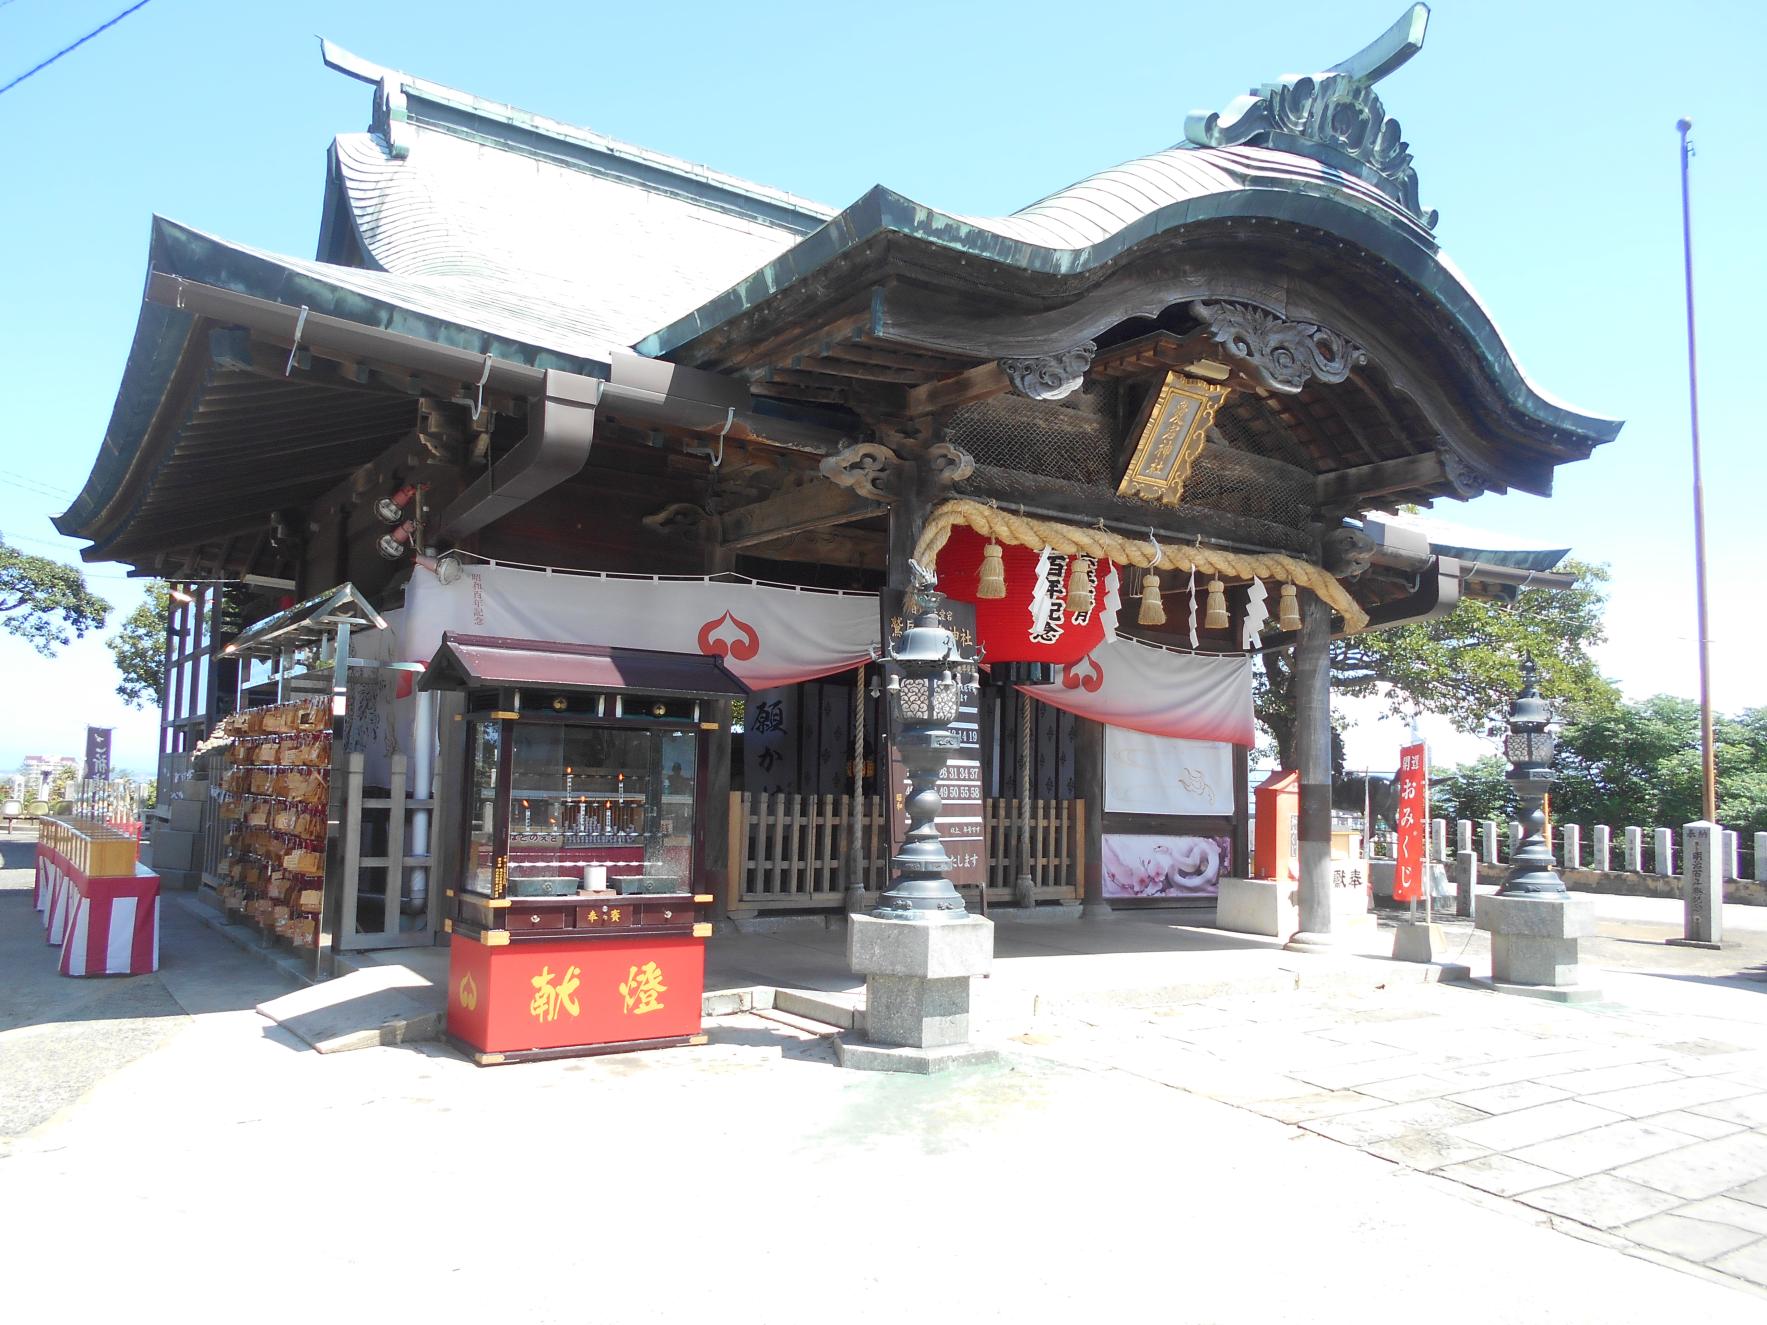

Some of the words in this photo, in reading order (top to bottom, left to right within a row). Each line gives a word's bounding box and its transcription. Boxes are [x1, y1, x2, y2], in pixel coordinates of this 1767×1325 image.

[471, 573, 485, 626] 昭和百年記念
[969, 731, 978, 742] 19
[1402, 754, 1420, 770] 開運
[949, 767, 958, 778] 31
[960, 768, 969, 779] 34
[970, 768, 979, 779] 37
[949, 786, 959, 798] 50
[960, 786, 970, 798] 55
[971, 787, 980, 798] 58
[895, 793, 903, 812] 昭和
[1401, 778, 1417, 888] おみくじ
